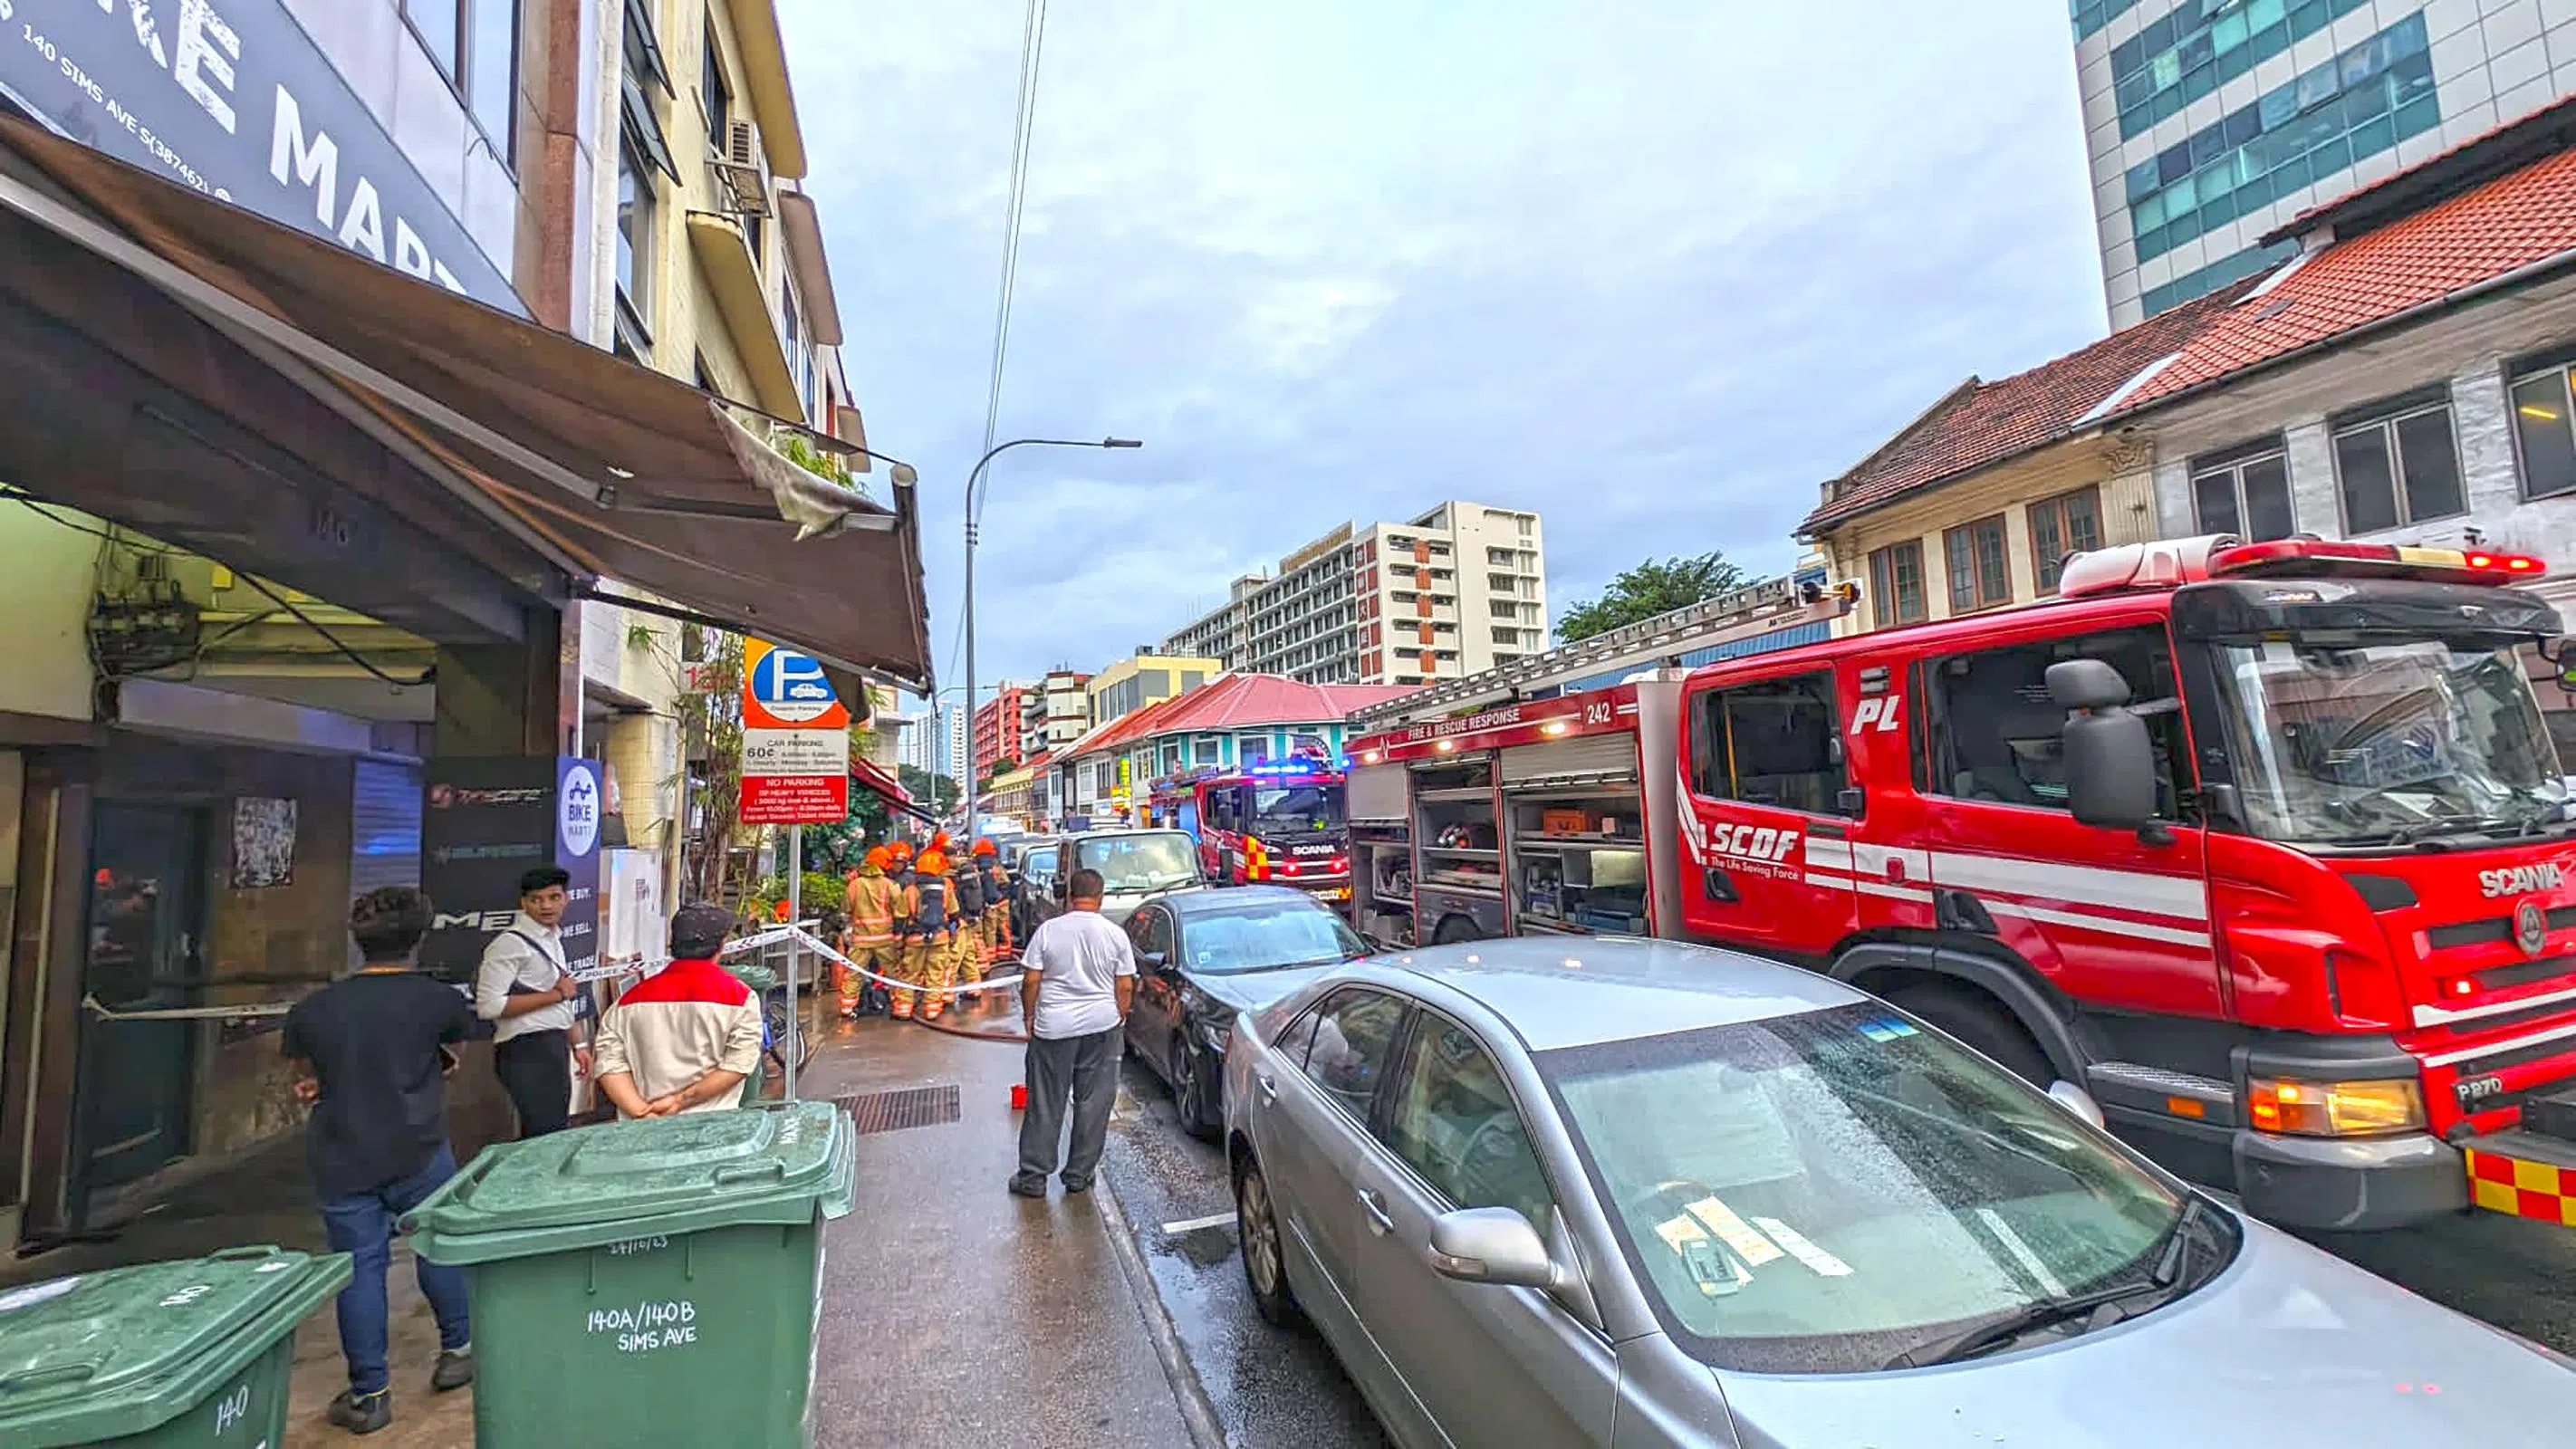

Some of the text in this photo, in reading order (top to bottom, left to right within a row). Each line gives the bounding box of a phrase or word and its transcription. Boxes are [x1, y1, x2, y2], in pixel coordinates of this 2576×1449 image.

[23, 24, 56, 62] 140
[60, 57, 103, 103] SIMS
[105, 99, 137, 134] AVE
[1408, 728, 1424, 741] FIRE
[1434, 720, 1466, 736] RESCUE
[1468, 708, 1521, 730] RESPONSE
[1587, 702, 1611, 724] 242
[1850, 695, 1901, 735] PL
[783, 778, 824, 786] PARKING
[568, 804, 591, 821] BIKE
[1293, 844, 1336, 855] SCANIA
[1709, 822, 1800, 861] SCDF
[1711, 856, 1799, 880] The Life Saving Force
[2478, 862, 2565, 897] SCANIA
[618, 1326, 697, 1352] SIMS AVE
[216, 1384, 249, 1436] 140
